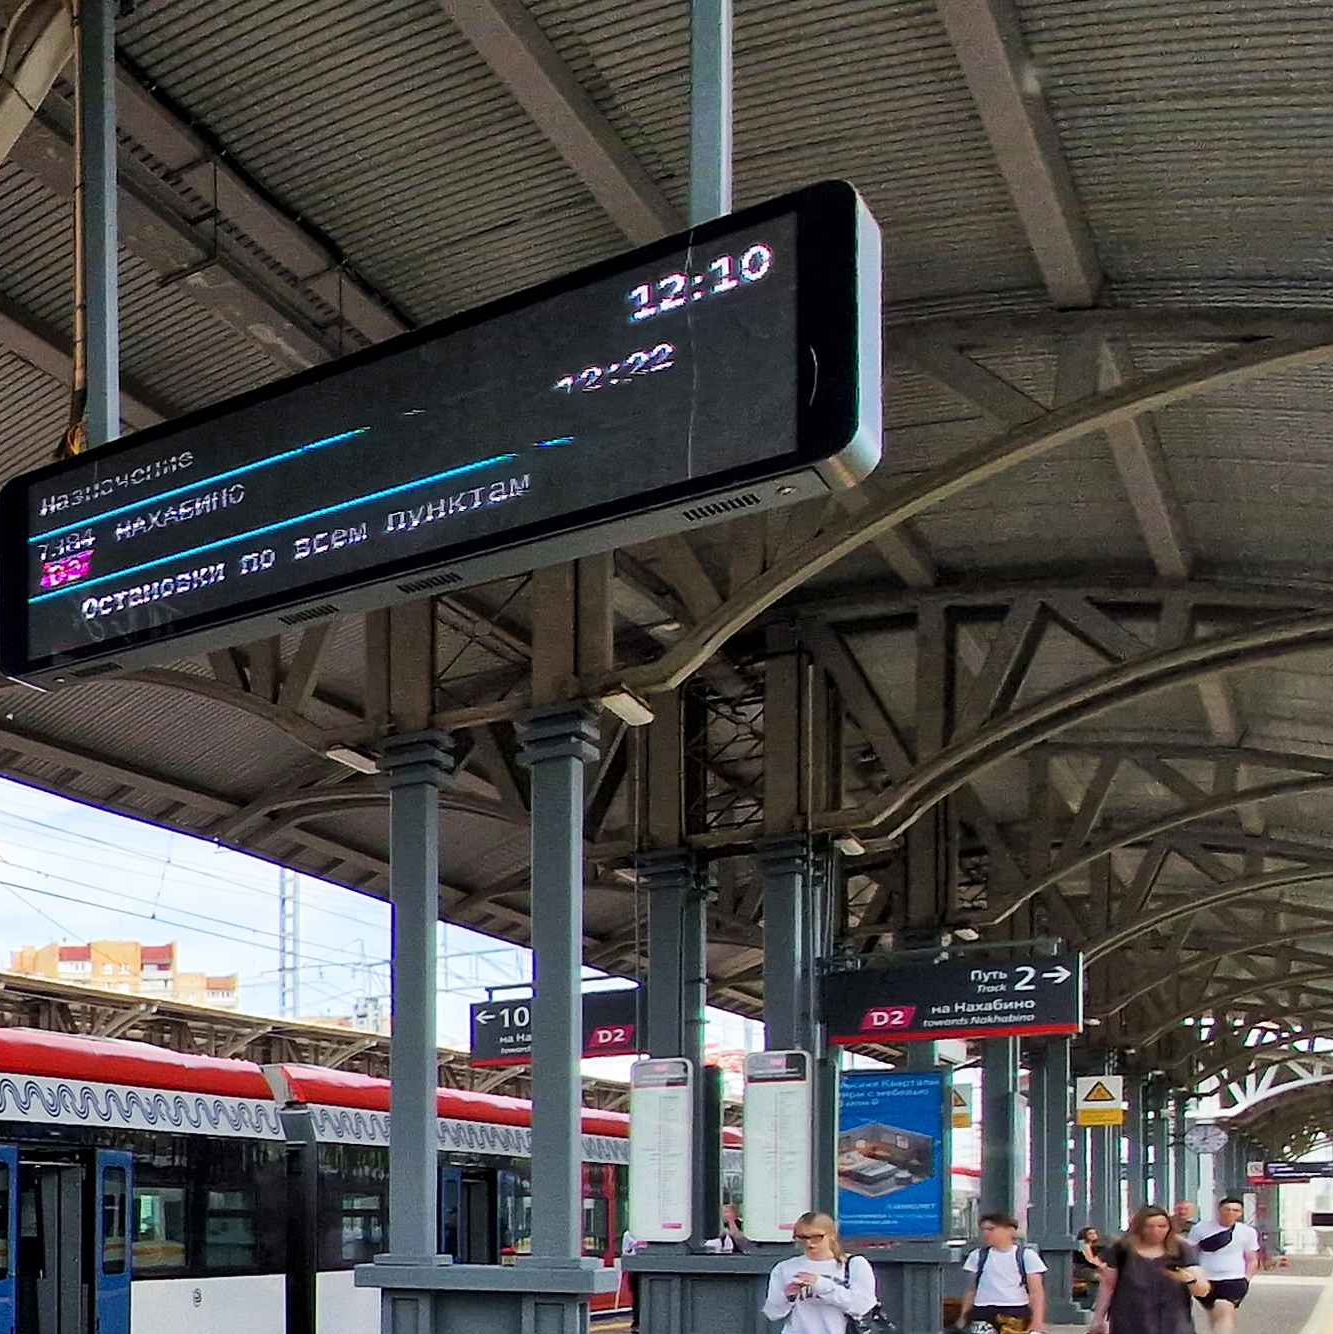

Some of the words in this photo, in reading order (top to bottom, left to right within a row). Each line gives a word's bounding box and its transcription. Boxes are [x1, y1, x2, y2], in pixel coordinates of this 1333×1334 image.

[628, 241, 773, 321] 12:10
[239, 549, 276, 575] по
[293, 523, 368, 560] всем
[385, 473, 531, 533] пунктам
[970, 969, 1008, 983] Путь
[1014, 965, 1036, 991] 2
[977, 984, 1006, 993] Track
[932, 1005, 951, 1014] на
[954, 998, 1036, 1013] Нахабино
[500, 1006, 530, 1028] 10
[871, 1010, 905, 1026] D2
[923, 1017, 968, 1027] towards
[969, 1013, 1035, 1025] Nakhabino
[597, 1028, 625, 1043] D2
